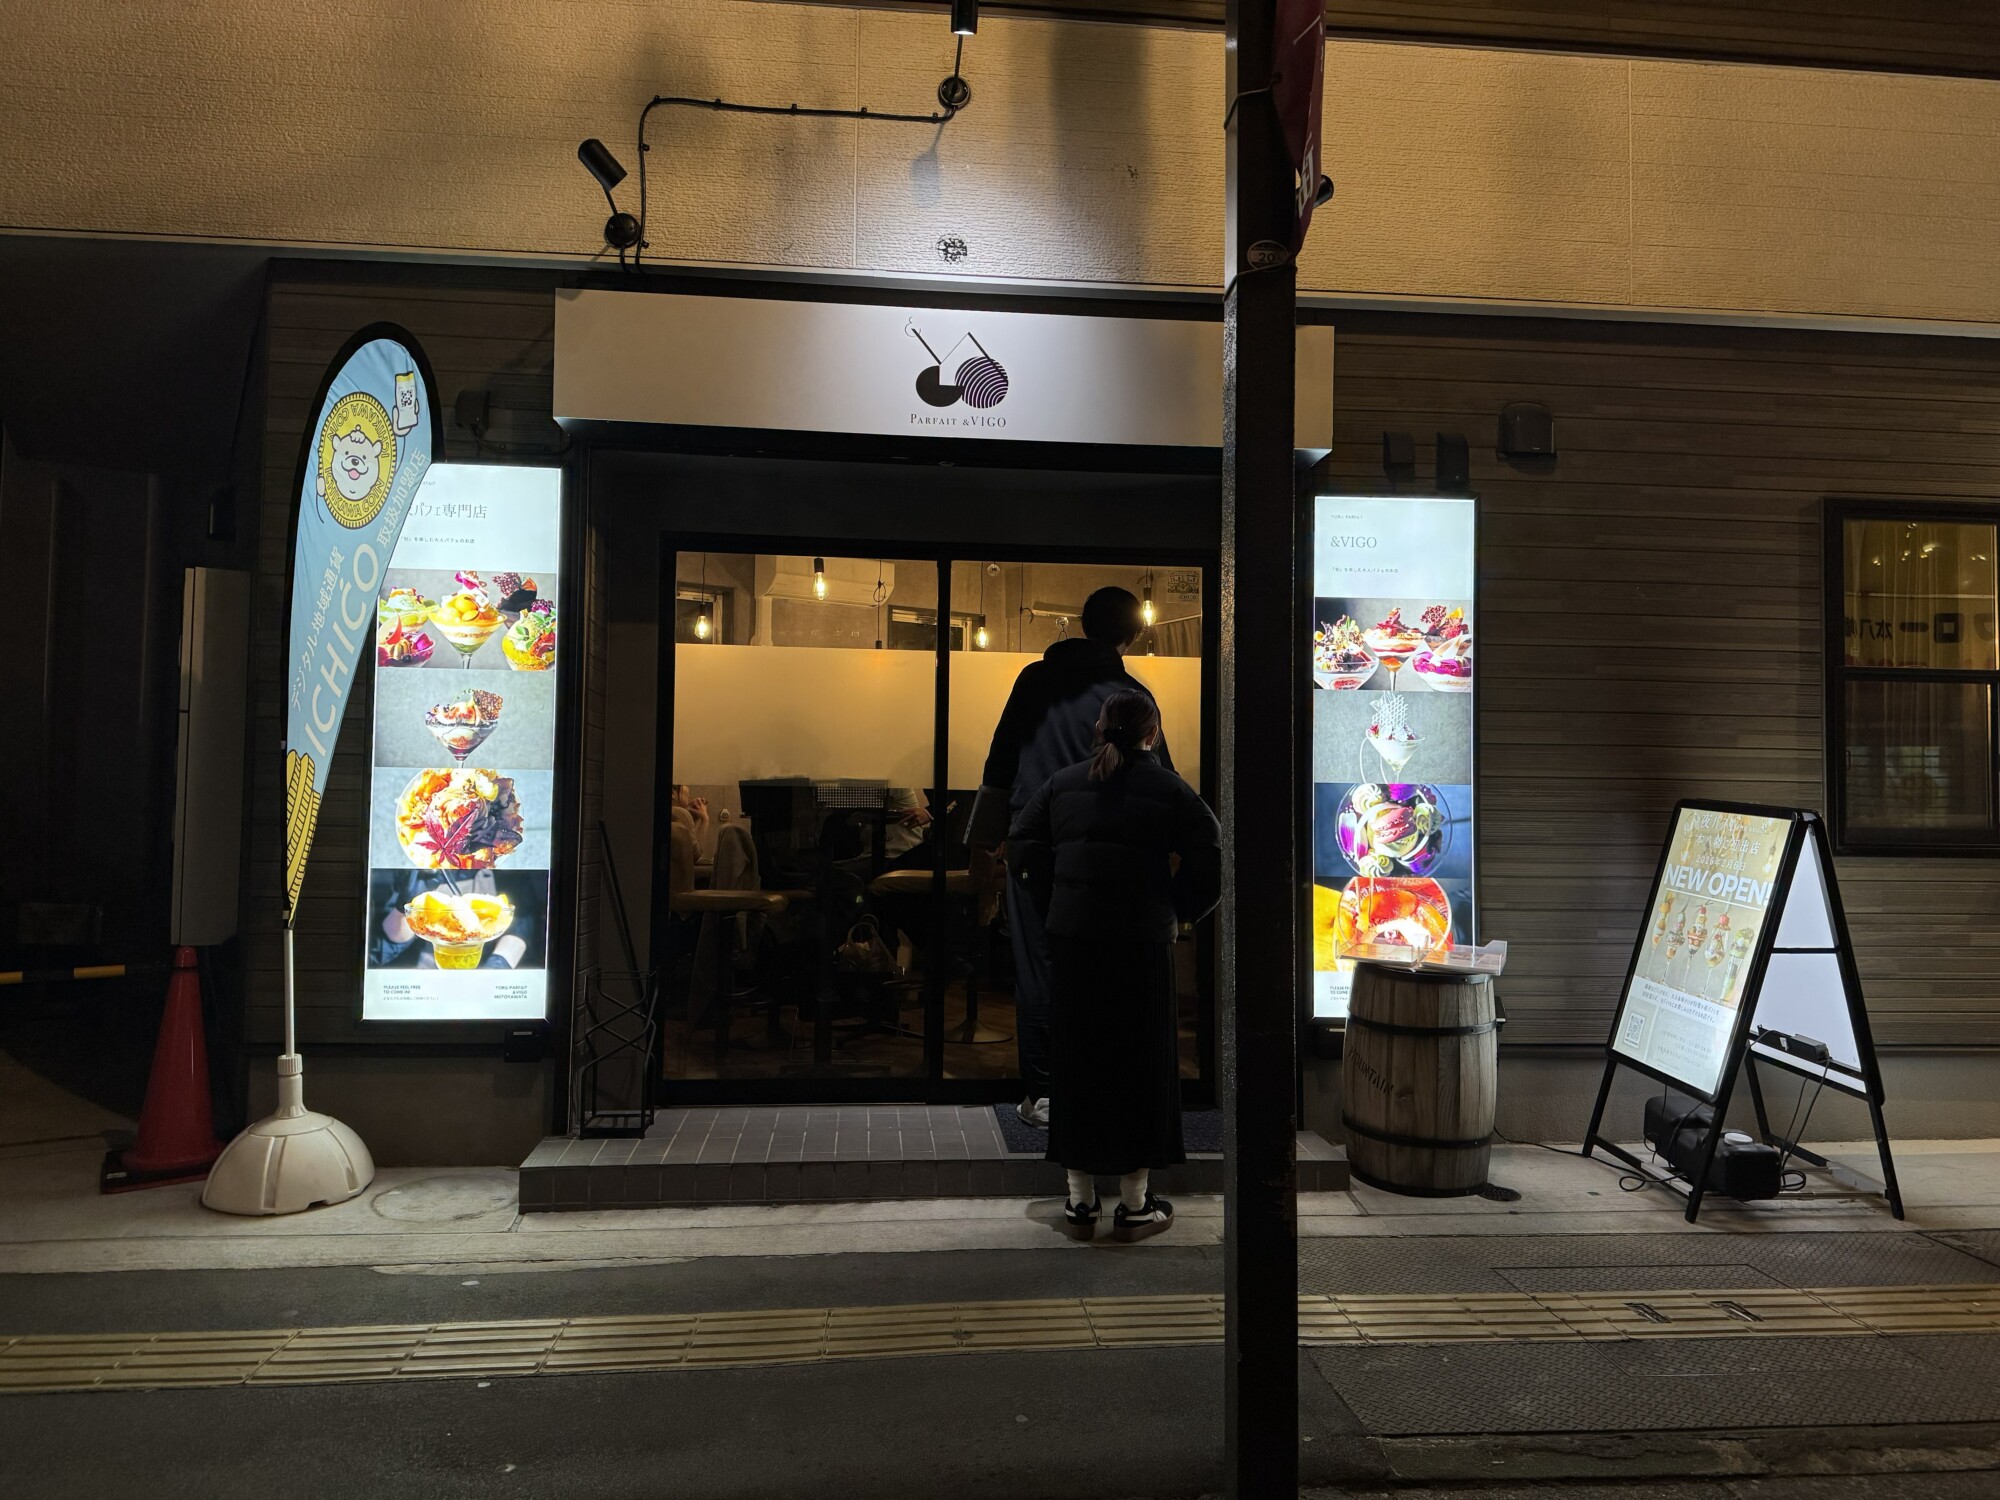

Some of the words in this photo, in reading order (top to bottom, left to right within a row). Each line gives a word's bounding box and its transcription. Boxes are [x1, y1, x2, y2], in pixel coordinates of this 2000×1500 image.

[1259, 252, 1275, 262] 20
[327, 407, 349, 441] COIN
[350, 403, 390, 459] ICHIKAWA
[962, 416, 1007, 428] &VIGO
[325, 467, 363, 518] ICHIKAWA
[361, 479, 386, 513] COIN
[377, 447, 427, 548] 取扱加盟店
[1330, 535, 1378, 549] &VIGO
[291, 545, 345, 711] デジタル地域通貨
[304, 543, 379, 757] ICHICO
[1663, 863, 1709, 892] NEW
[1707, 872, 1774, 907] OPEN!
